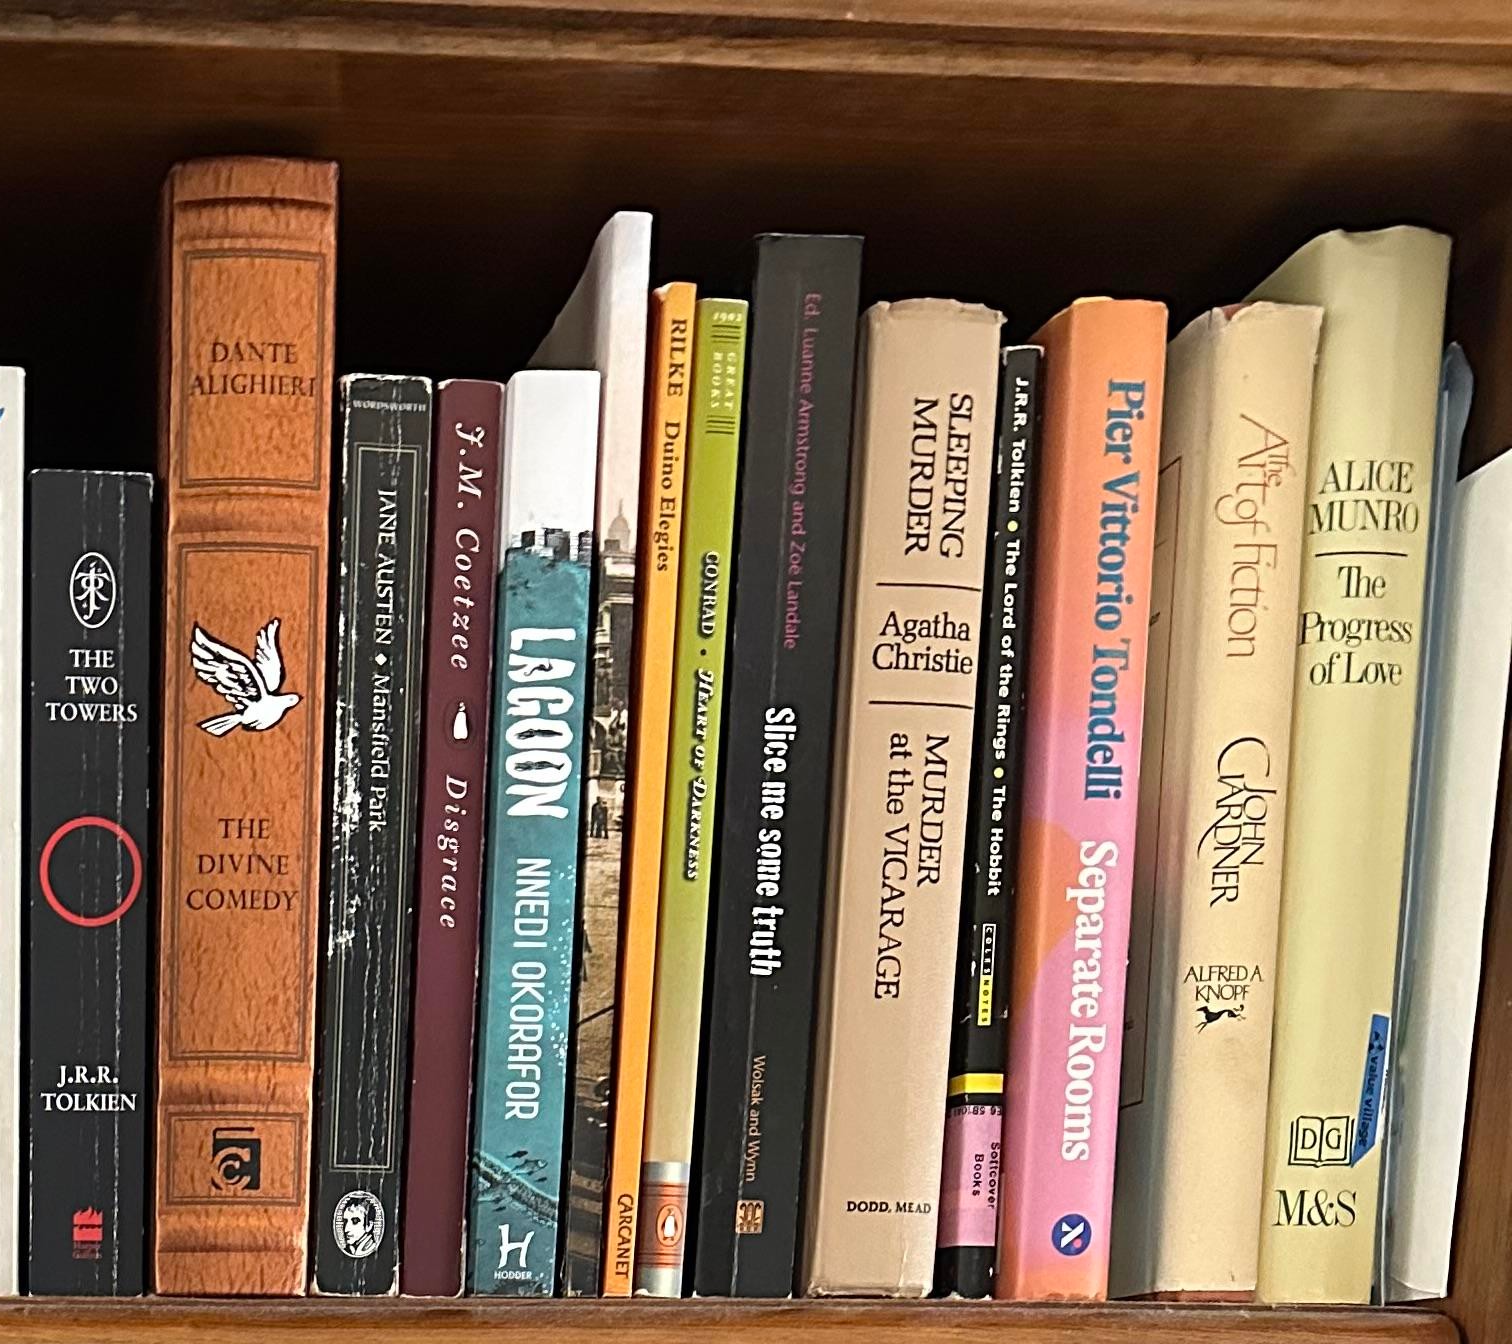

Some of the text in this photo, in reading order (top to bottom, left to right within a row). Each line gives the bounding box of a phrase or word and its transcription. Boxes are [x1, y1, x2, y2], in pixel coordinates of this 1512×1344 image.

[211, 343, 297, 364] DANTE
[190, 374, 316, 397] ALIGHIERI
[1318, 460, 1414, 494] ALICE
[1308, 500, 1419, 535] MUNRO
[1338, 566, 1386, 600] The
[880, 611, 970, 641] Agatha
[1298, 612, 1413, 648] Progress
[69, 649, 115, 669] THE
[872, 644, 972, 675] Christie
[1309, 652, 1402, 686] of Love
[66, 676, 118, 695] TWO
[45, 702, 137, 722] TOWERS
[218, 819, 269, 840] THE
[198, 854, 288, 876] DIVINE
[504, 628, 577, 1120] LAGOON NNEDI OKORAFOR
[187, 890, 298, 911] COMEDY
[58, 1065, 118, 1085] J.R.R.
[40, 1092, 137, 1112] TOLKIEN
[745, 1055, 767, 1183] Wolsak and Wynn
[896, 1202, 931, 1214] MEAD
[616, 1193, 636, 1279] CARCANET
[494, 1270, 532, 1280] HODDER
